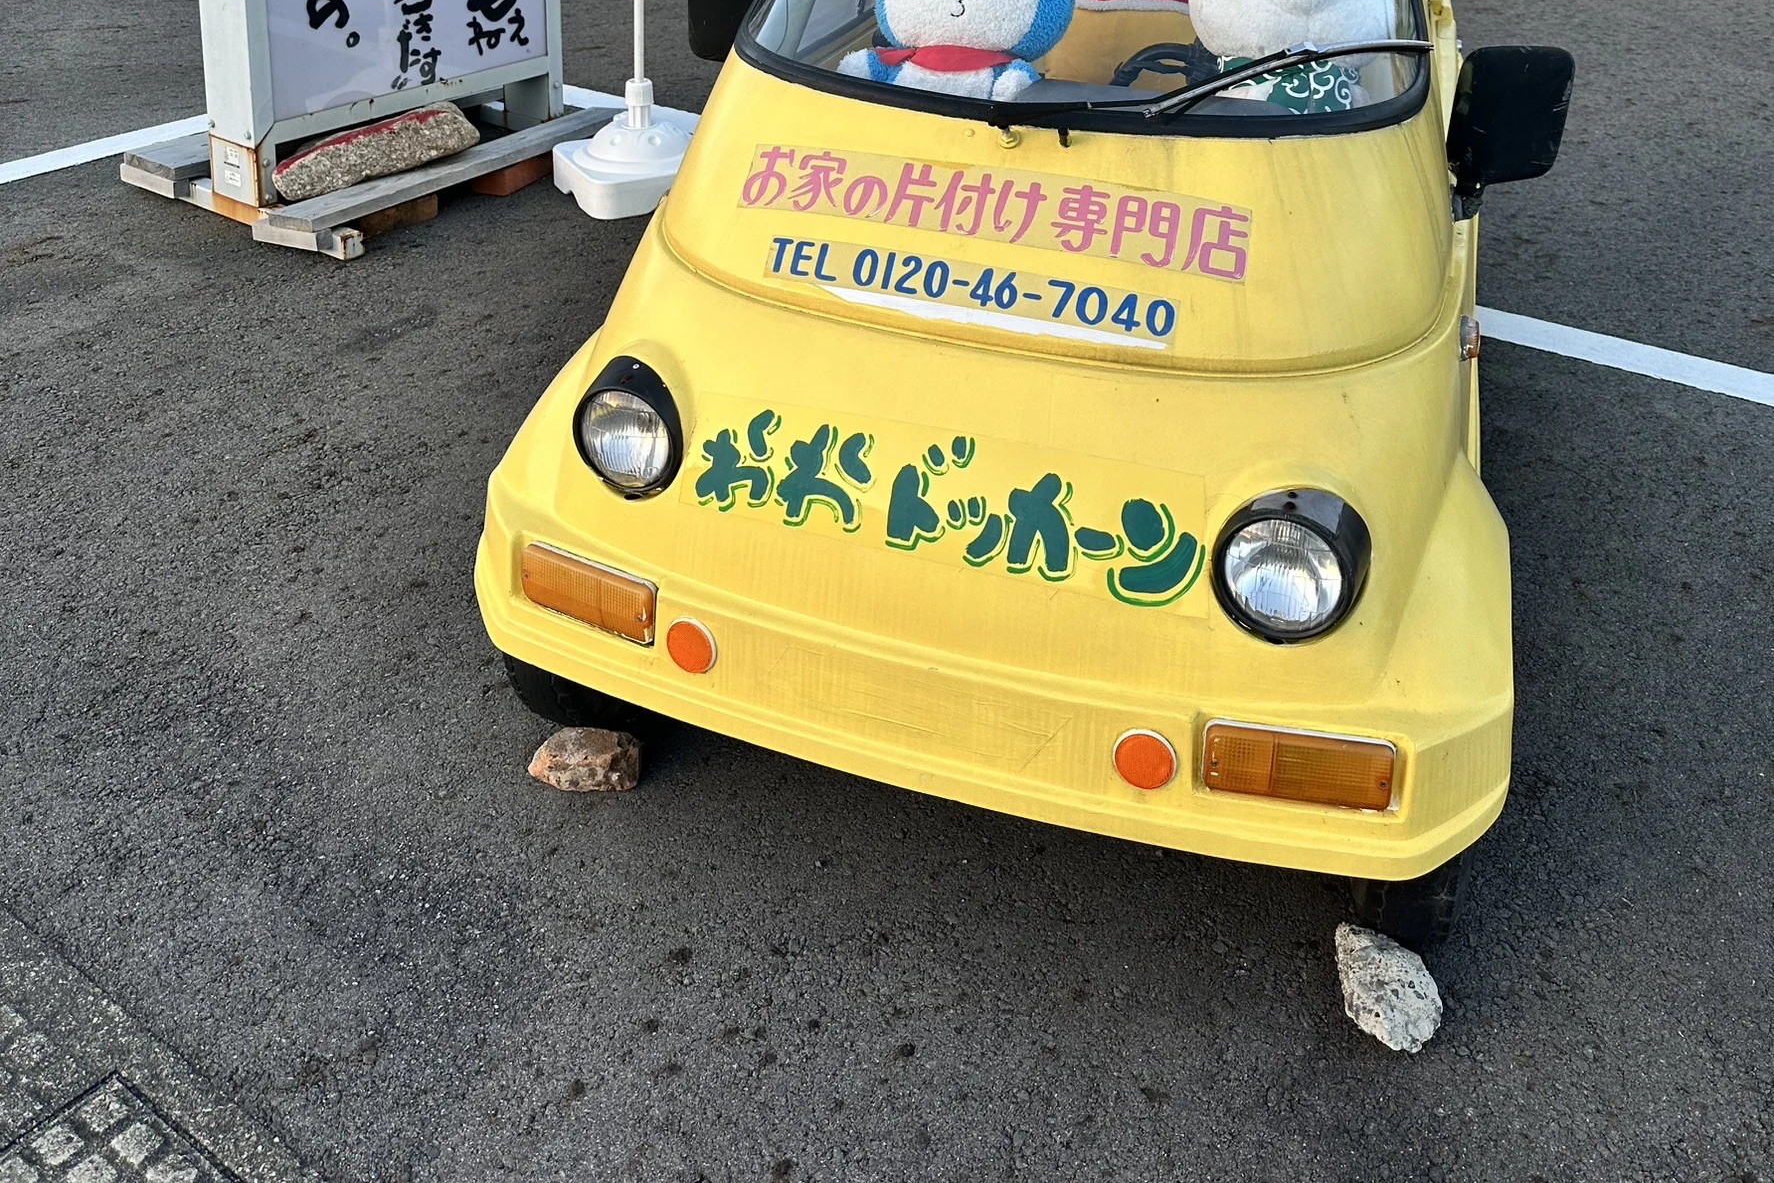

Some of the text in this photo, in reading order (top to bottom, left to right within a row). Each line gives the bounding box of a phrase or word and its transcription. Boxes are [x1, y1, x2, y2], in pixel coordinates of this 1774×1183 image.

[741, 145, 1250, 280] お家の片付け専門店
[771, 236, 1176, 338] TEL 0120-46-7040
